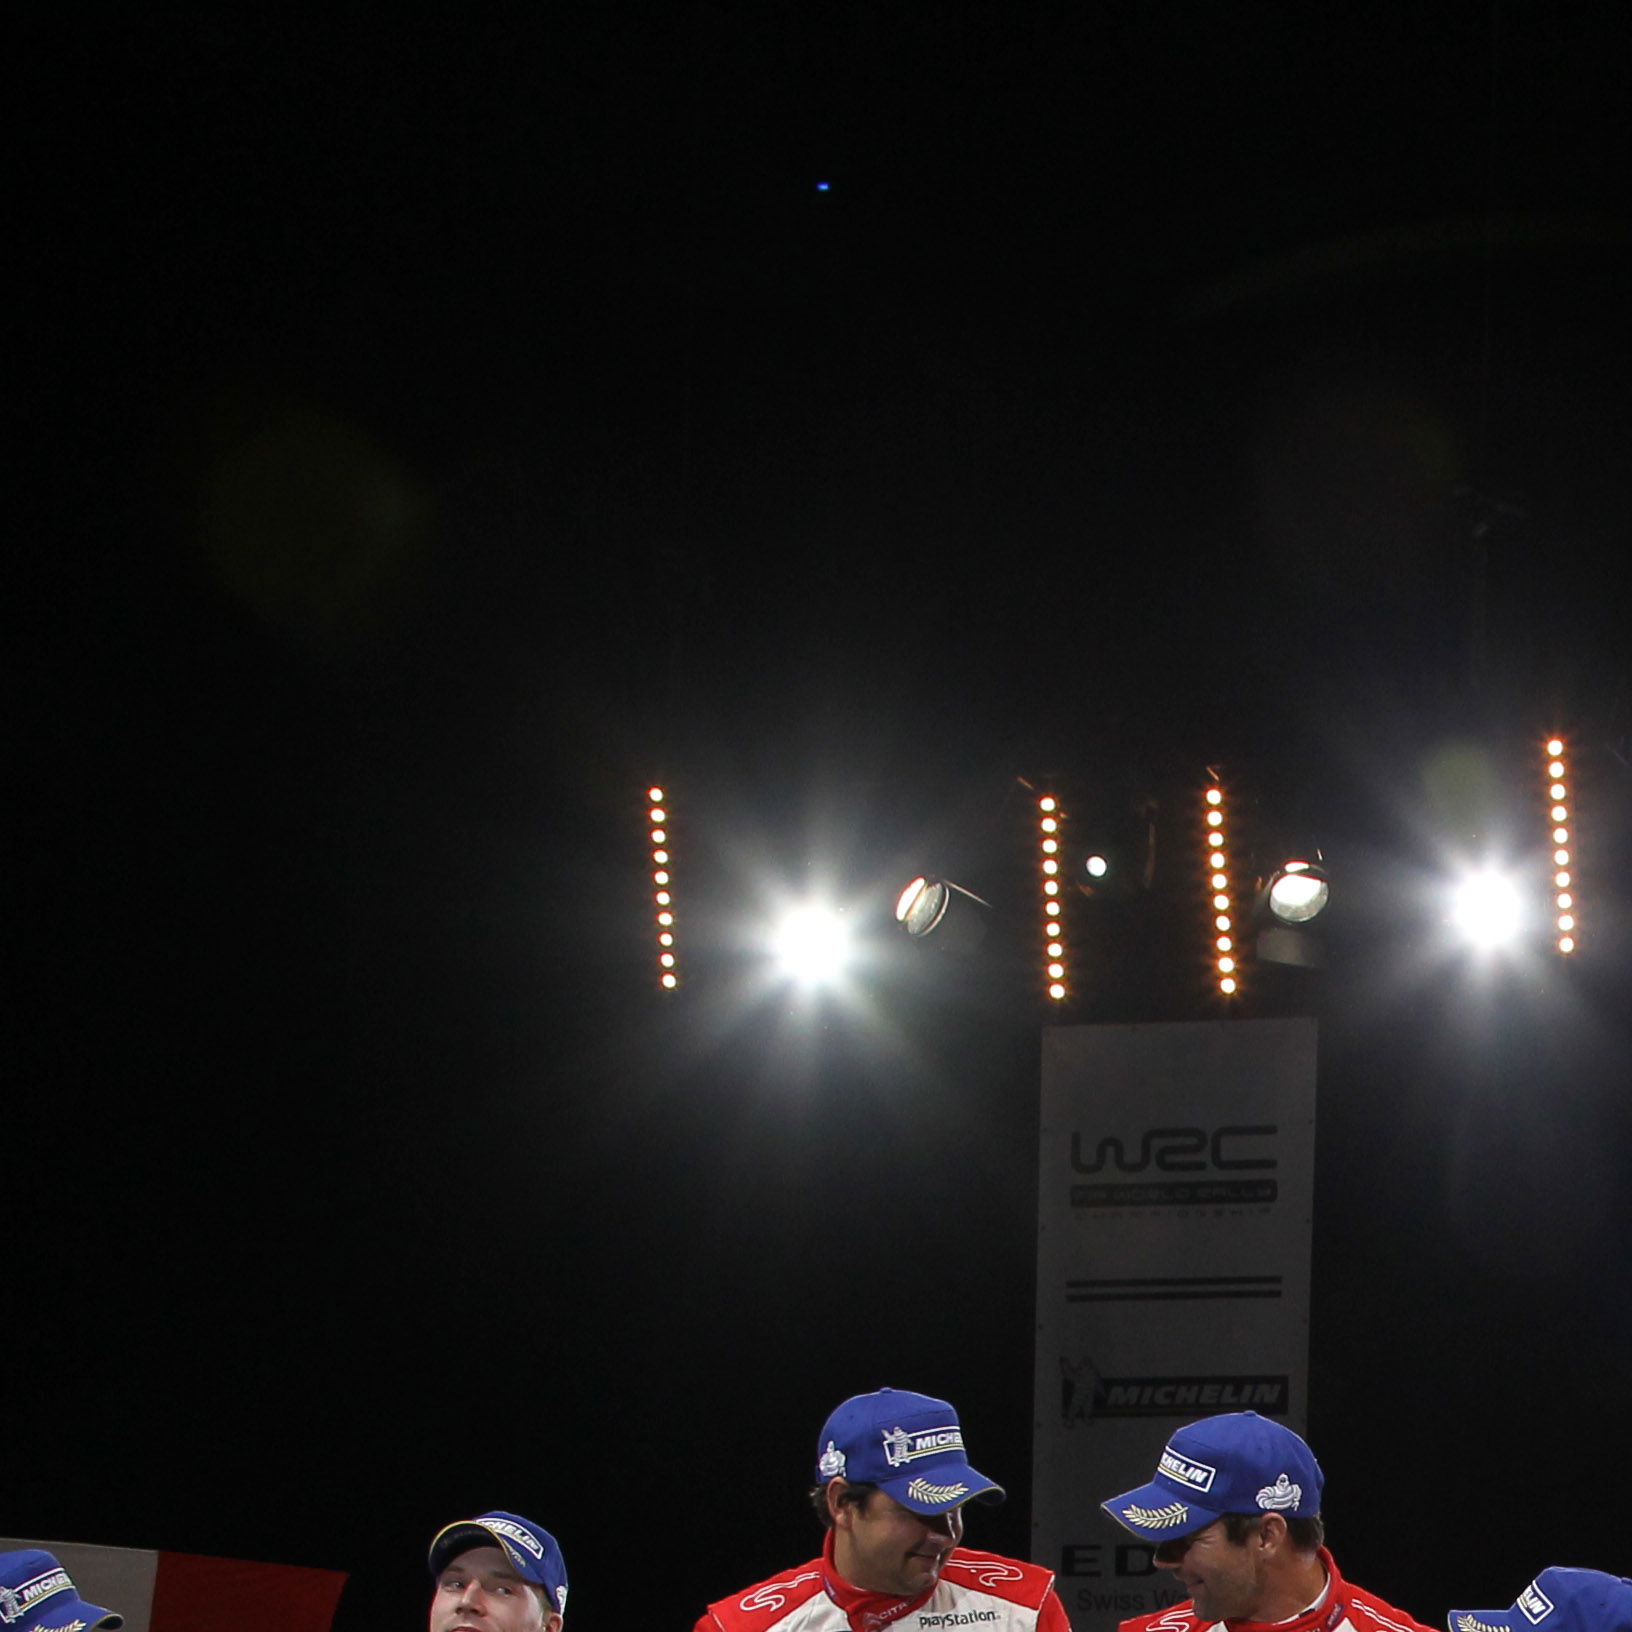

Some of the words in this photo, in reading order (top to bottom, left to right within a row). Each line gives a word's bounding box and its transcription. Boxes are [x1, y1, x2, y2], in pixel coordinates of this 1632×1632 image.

[1070, 1124, 1278, 1174] WRC
[1105, 1383, 1282, 1406] MICHELIN
[1077, 1589, 1151, 1612] Swiss
[920, 1609, 996, 1629] PlayStation
